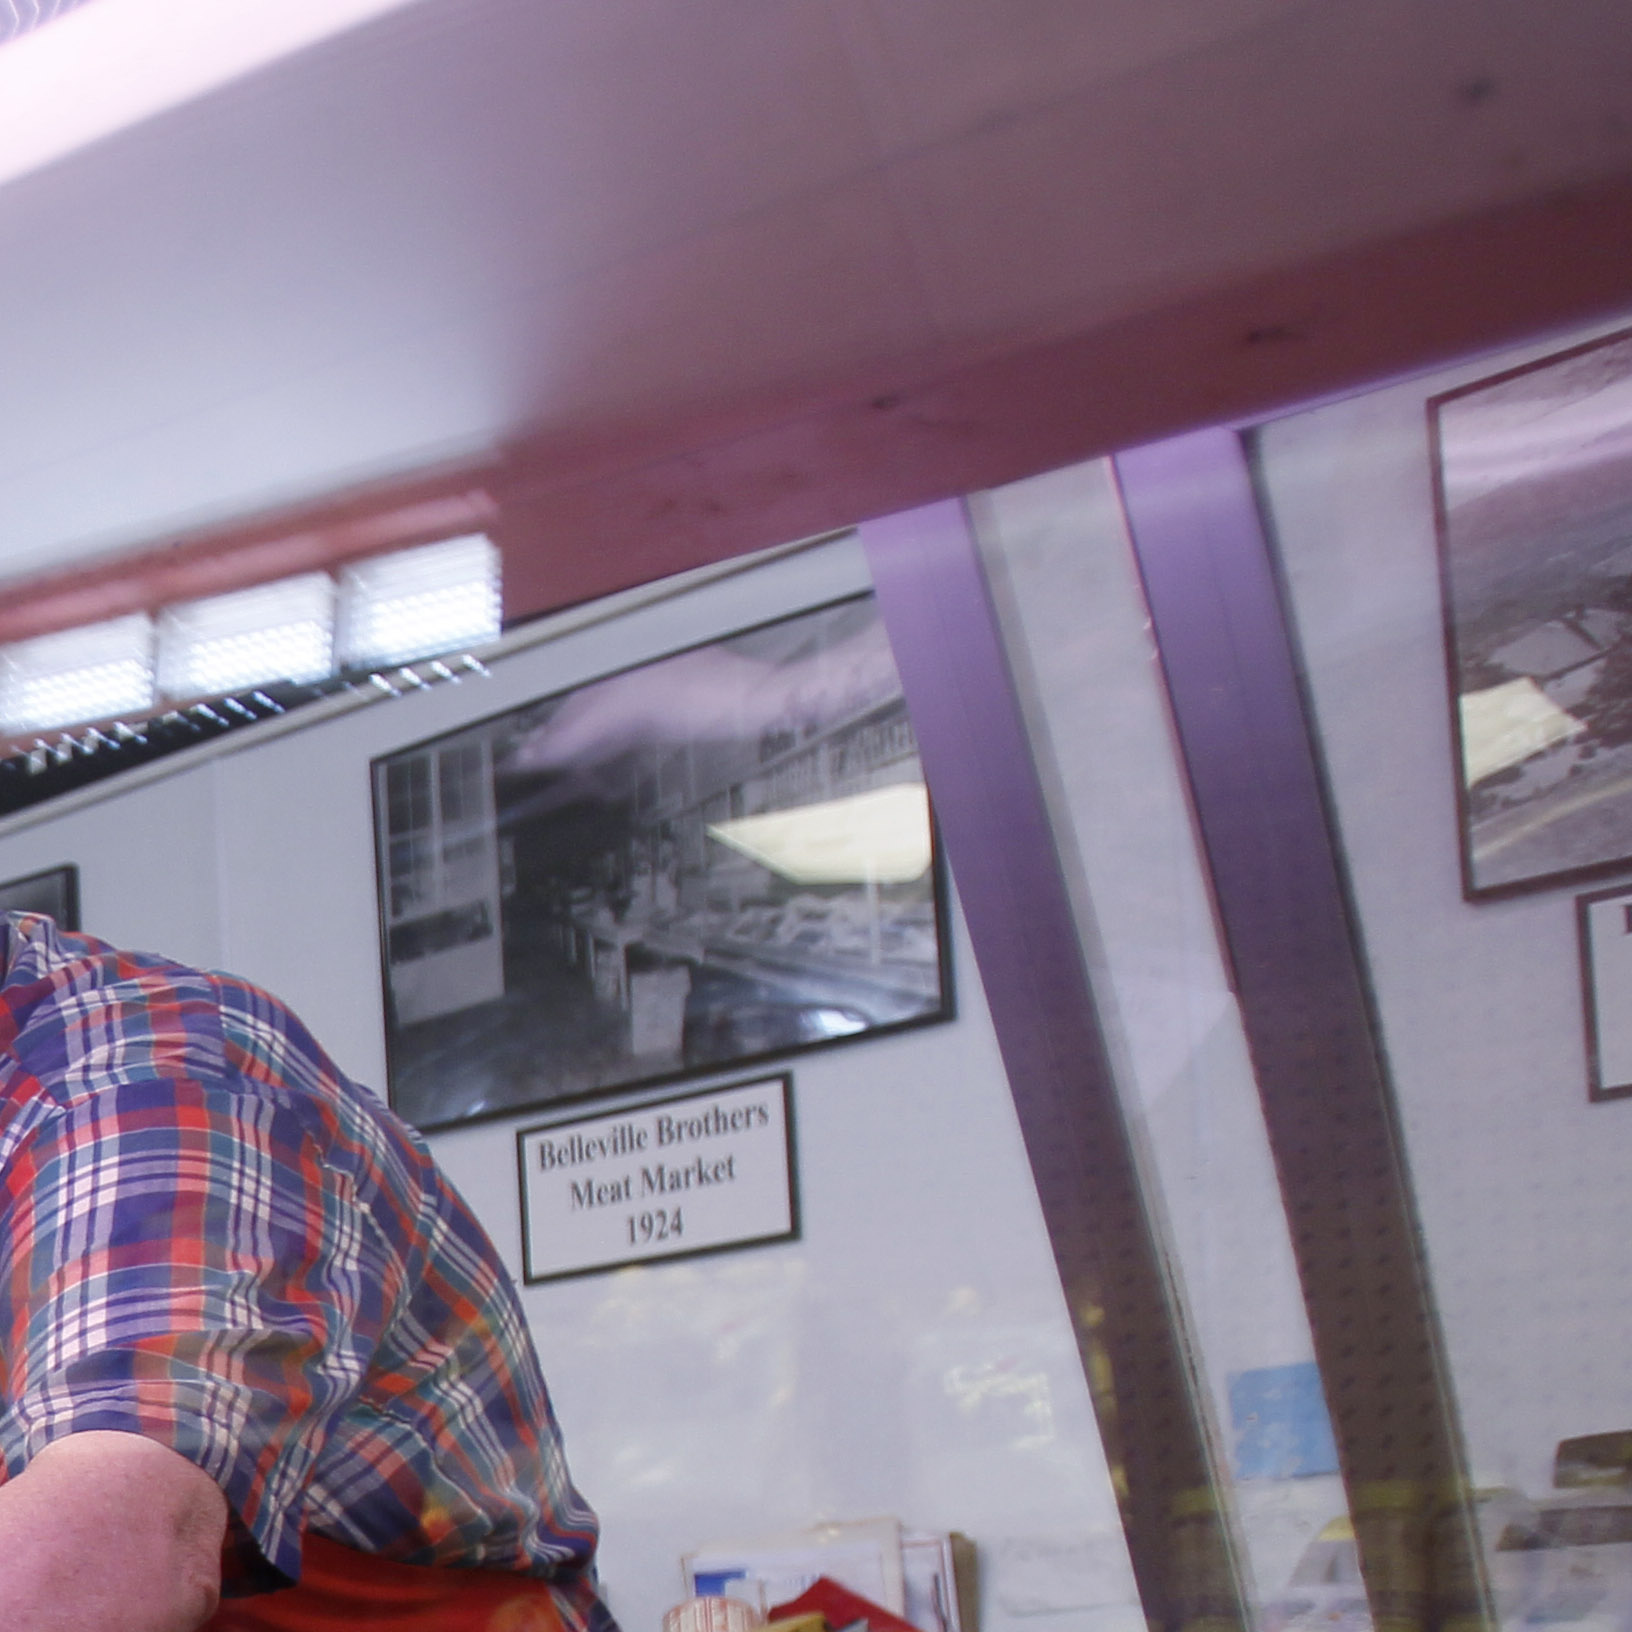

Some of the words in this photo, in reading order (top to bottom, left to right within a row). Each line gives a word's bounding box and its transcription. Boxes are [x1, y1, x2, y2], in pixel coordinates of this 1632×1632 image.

[537, 1122, 649, 1173] Belleville
[656, 1100, 769, 1147] Brothers
[569, 1178, 634, 1211] Meat
[640, 1153, 736, 1198] Market
[625, 1208, 685, 1247] 1924
